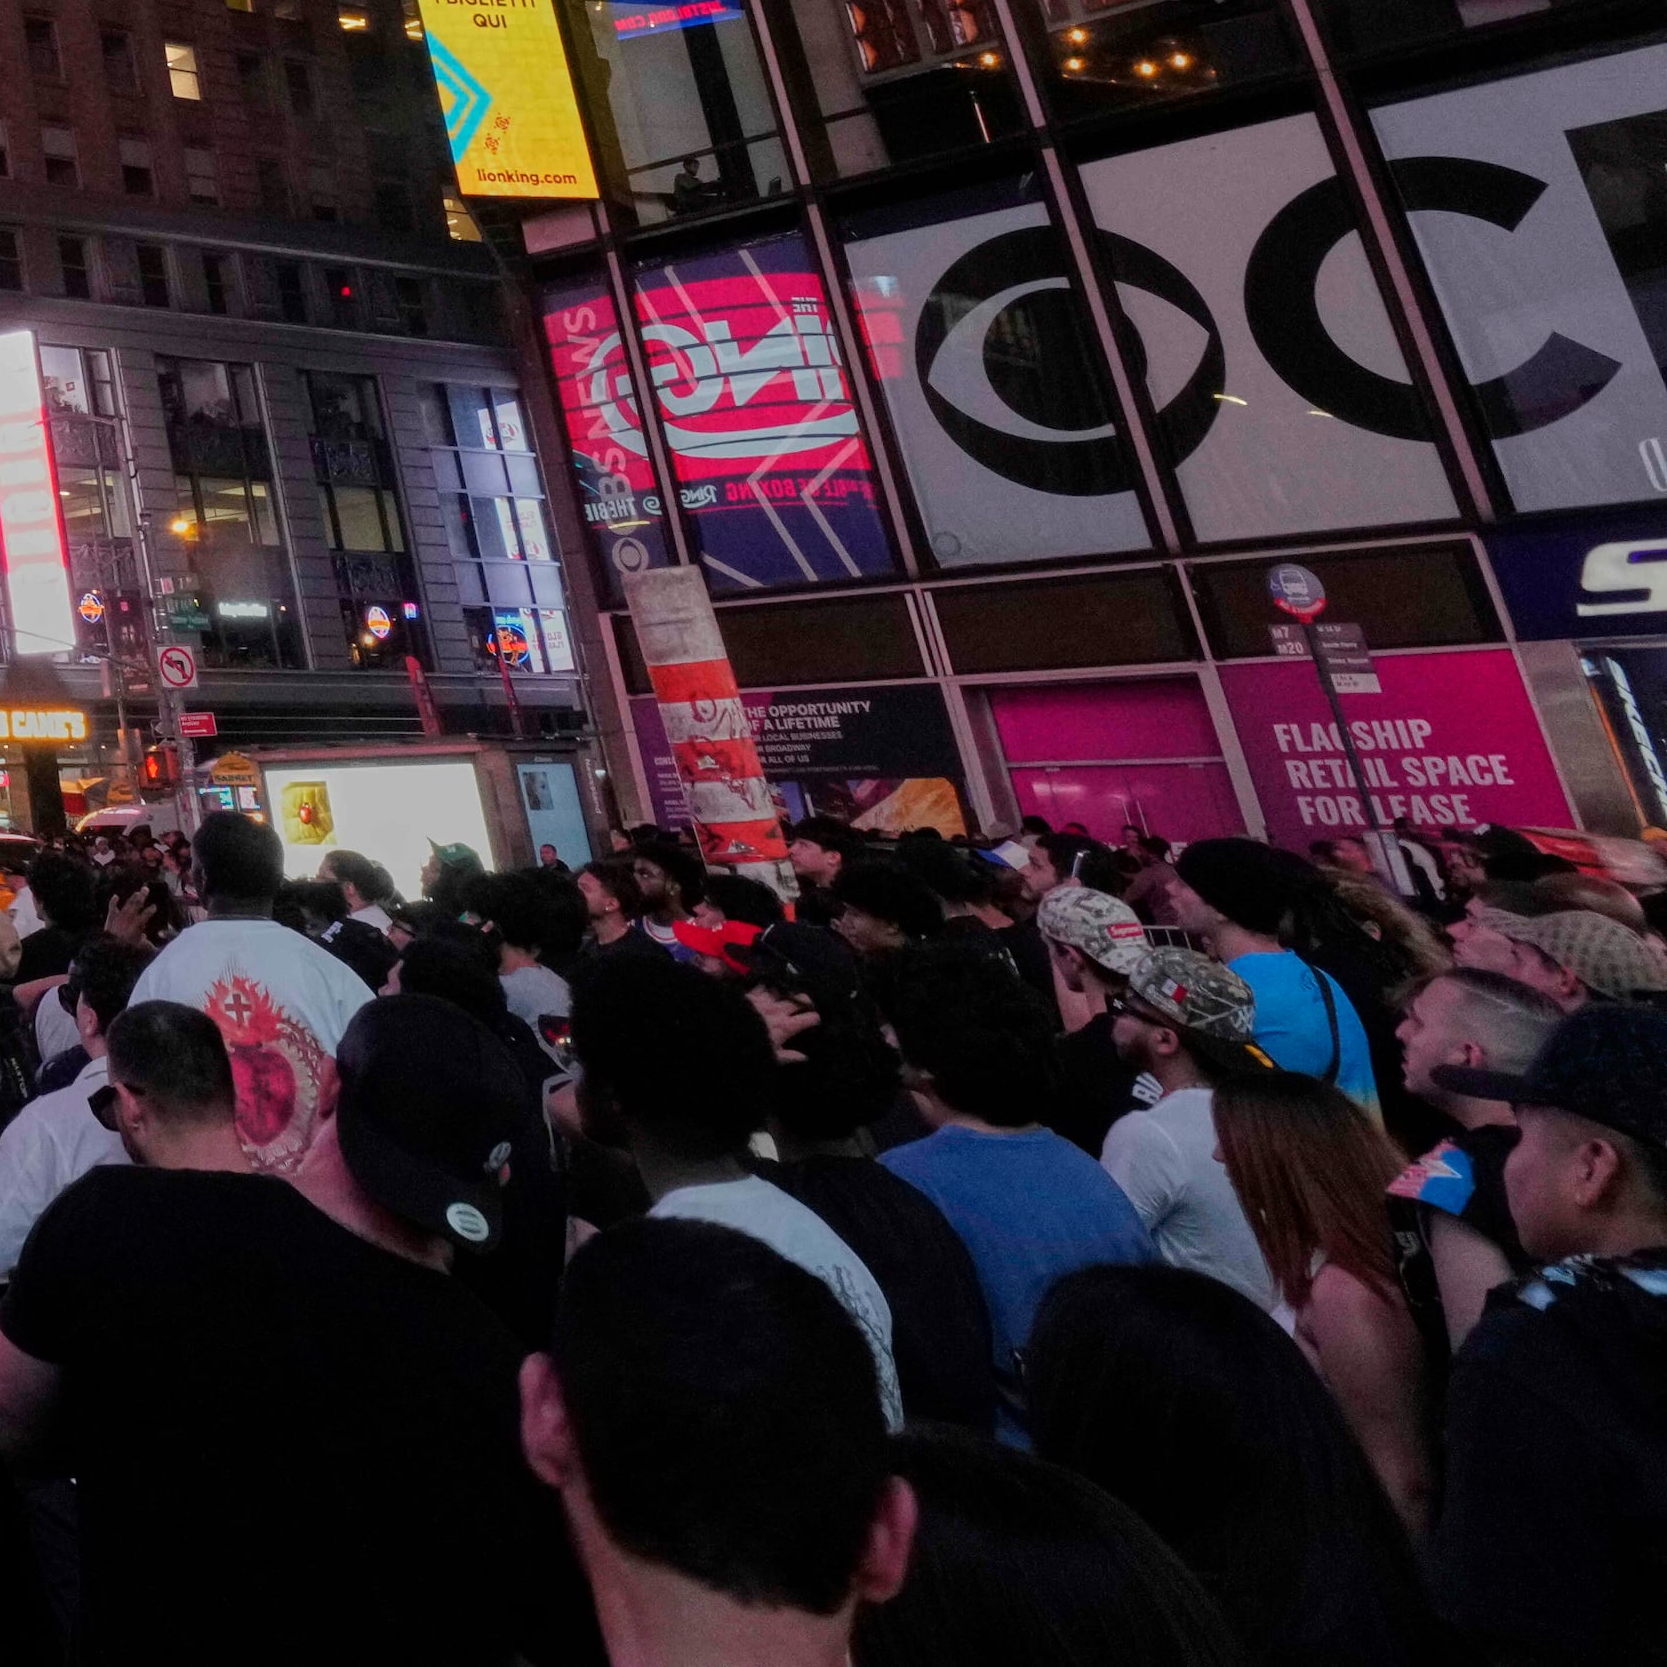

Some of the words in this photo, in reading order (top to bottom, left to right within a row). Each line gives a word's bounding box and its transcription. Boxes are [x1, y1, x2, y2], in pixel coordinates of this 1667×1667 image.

[473, 13, 508, 29] QUI
[477, 168, 577, 186] lionking.com
[1271, 627, 1289, 638] M7
[1278, 642, 1303, 654] M20
[769, 701, 870, 718] OPPORTUNITY
[12, 710, 85, 738] CANE'S
[763, 719, 773, 729] A
[775, 717, 841, 729] LIFETIME
[762, 732, 788, 741] LOCAL
[1273, 719, 1432, 753] FLAGSHIP
[766, 743, 811, 752] BROADWAY
[1407, 755, 1514, 786] SPACE
[1297, 795, 1365, 825] FOR
[1375, 794, 1476, 825] LEASE
